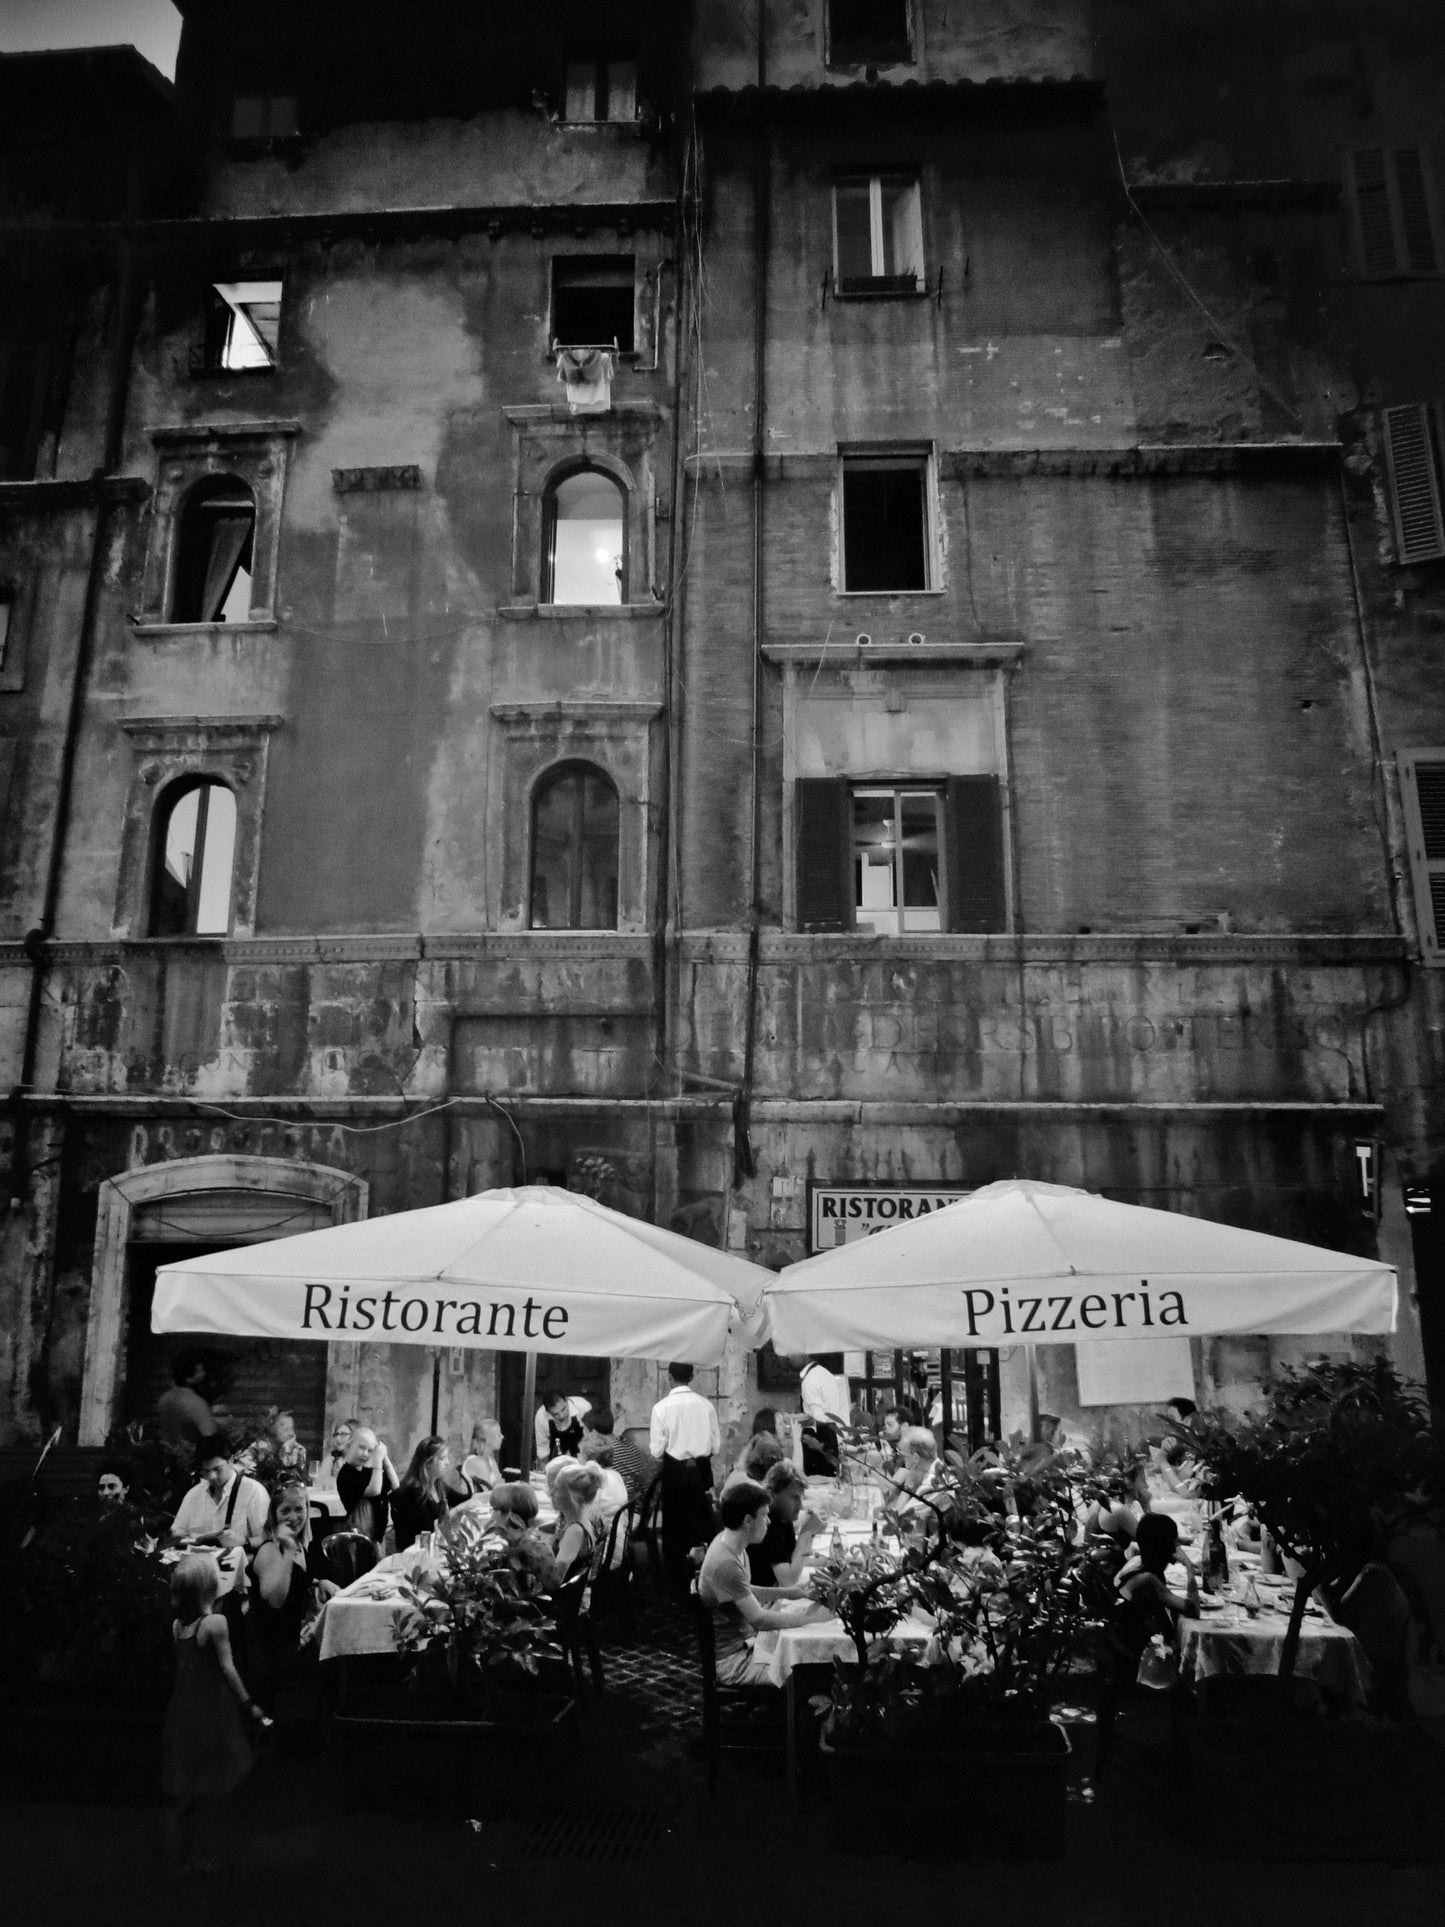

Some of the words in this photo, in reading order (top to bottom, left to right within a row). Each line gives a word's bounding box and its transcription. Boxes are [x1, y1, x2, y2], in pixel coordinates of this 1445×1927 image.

[822, 1197, 959, 1219] RISTORA
[300, 1283, 569, 1339] Ristorante
[961, 1279, 1189, 1336] Pizzeria
